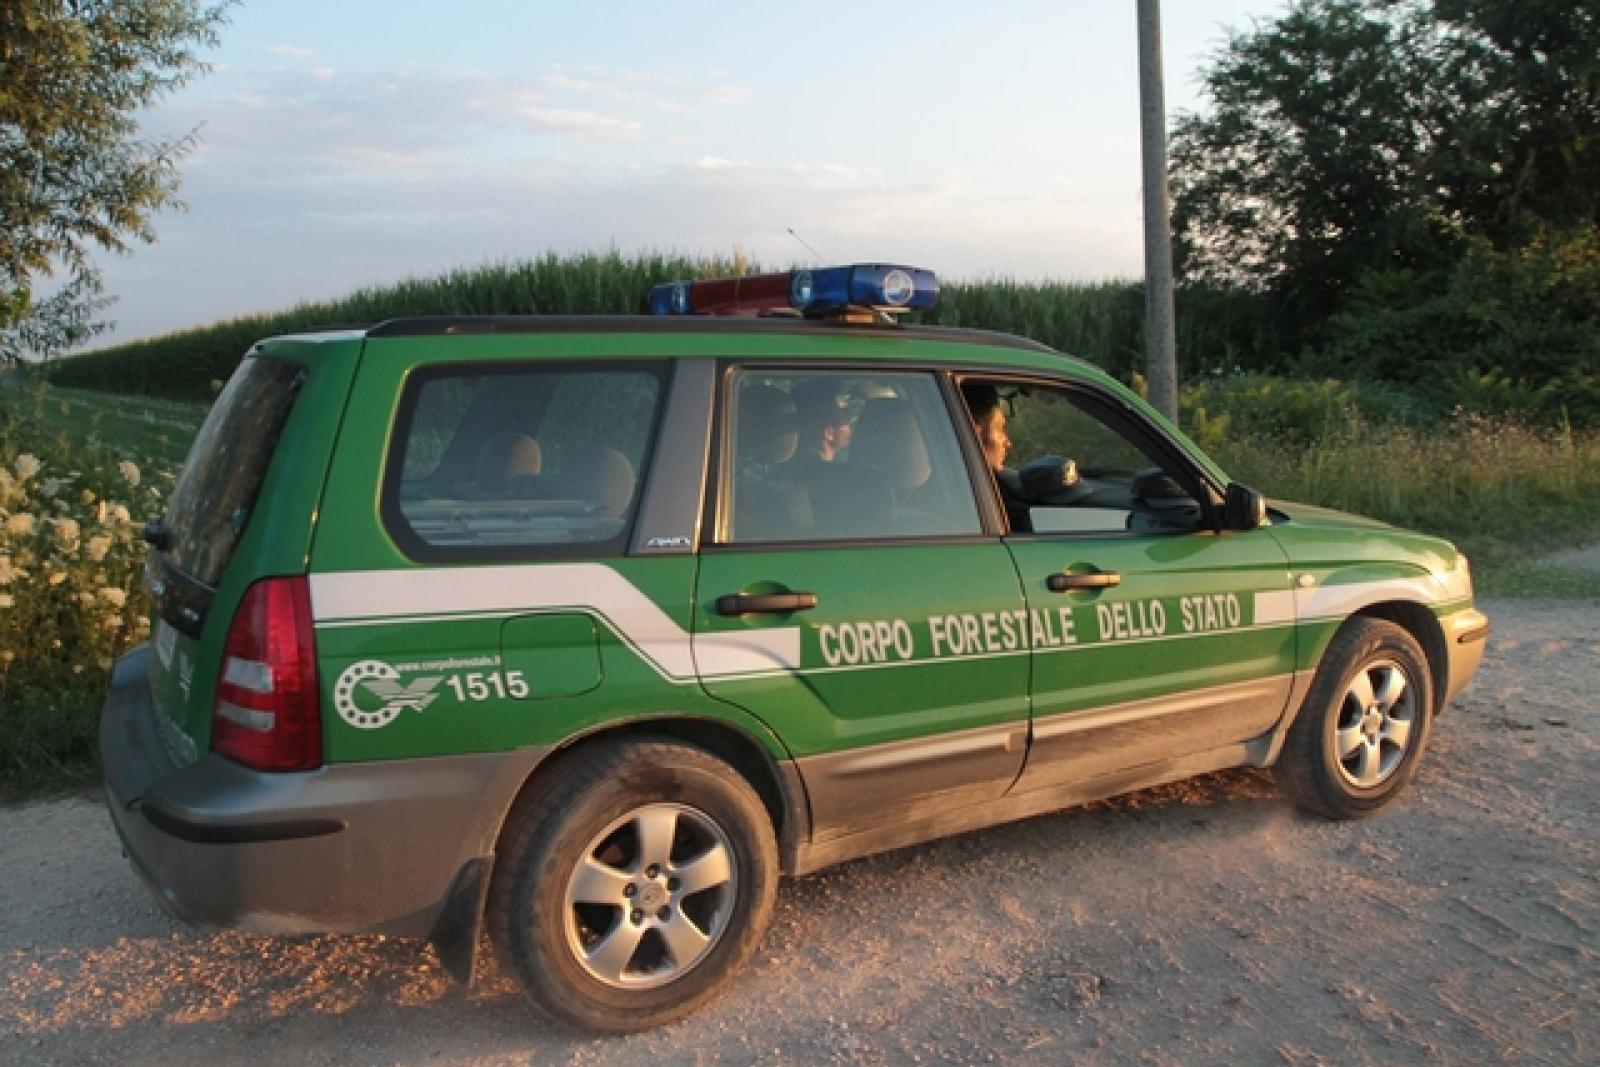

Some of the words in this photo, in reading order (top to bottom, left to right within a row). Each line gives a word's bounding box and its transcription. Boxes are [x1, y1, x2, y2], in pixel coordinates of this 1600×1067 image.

[819, 618, 913, 667] CORPO
[927, 607, 1077, 656] FORESTALE
[1096, 599, 1166, 640] DELLO
[1180, 592, 1241, 631] STATO
[447, 670, 529, 702] 1515
